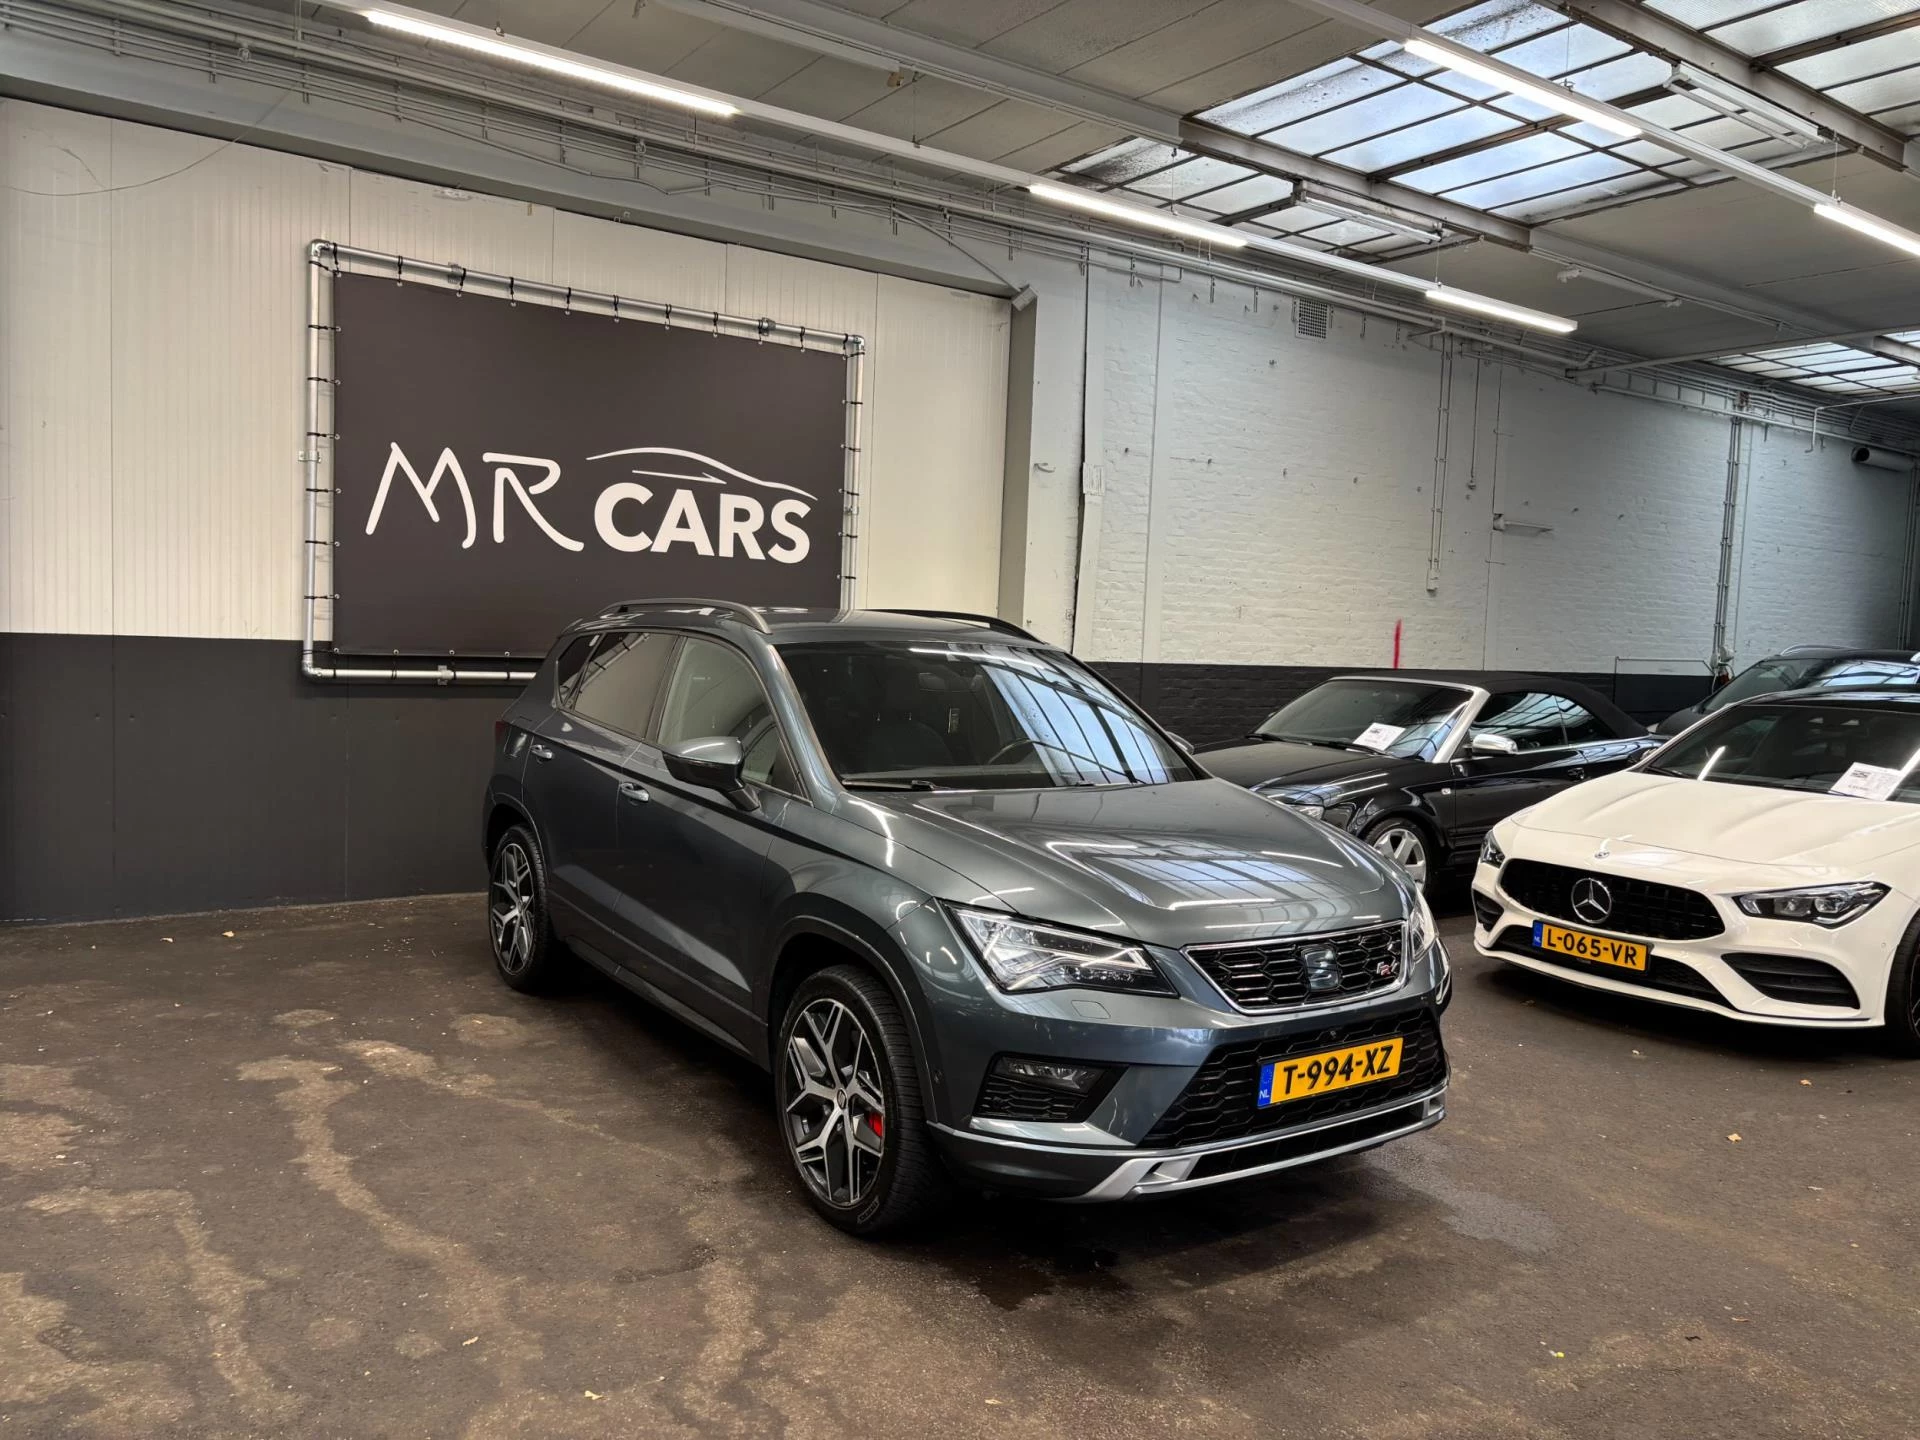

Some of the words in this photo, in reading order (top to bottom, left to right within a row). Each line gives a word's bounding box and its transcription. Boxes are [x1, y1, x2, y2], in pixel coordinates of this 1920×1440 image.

[366, 441, 585, 552] MR
[594, 482, 812, 564] CARS
[1547, 928, 1637, 966] L-065-VR
[1283, 1045, 1393, 1095] T-994-XZ
[1259, 1089, 1270, 1099] NL
